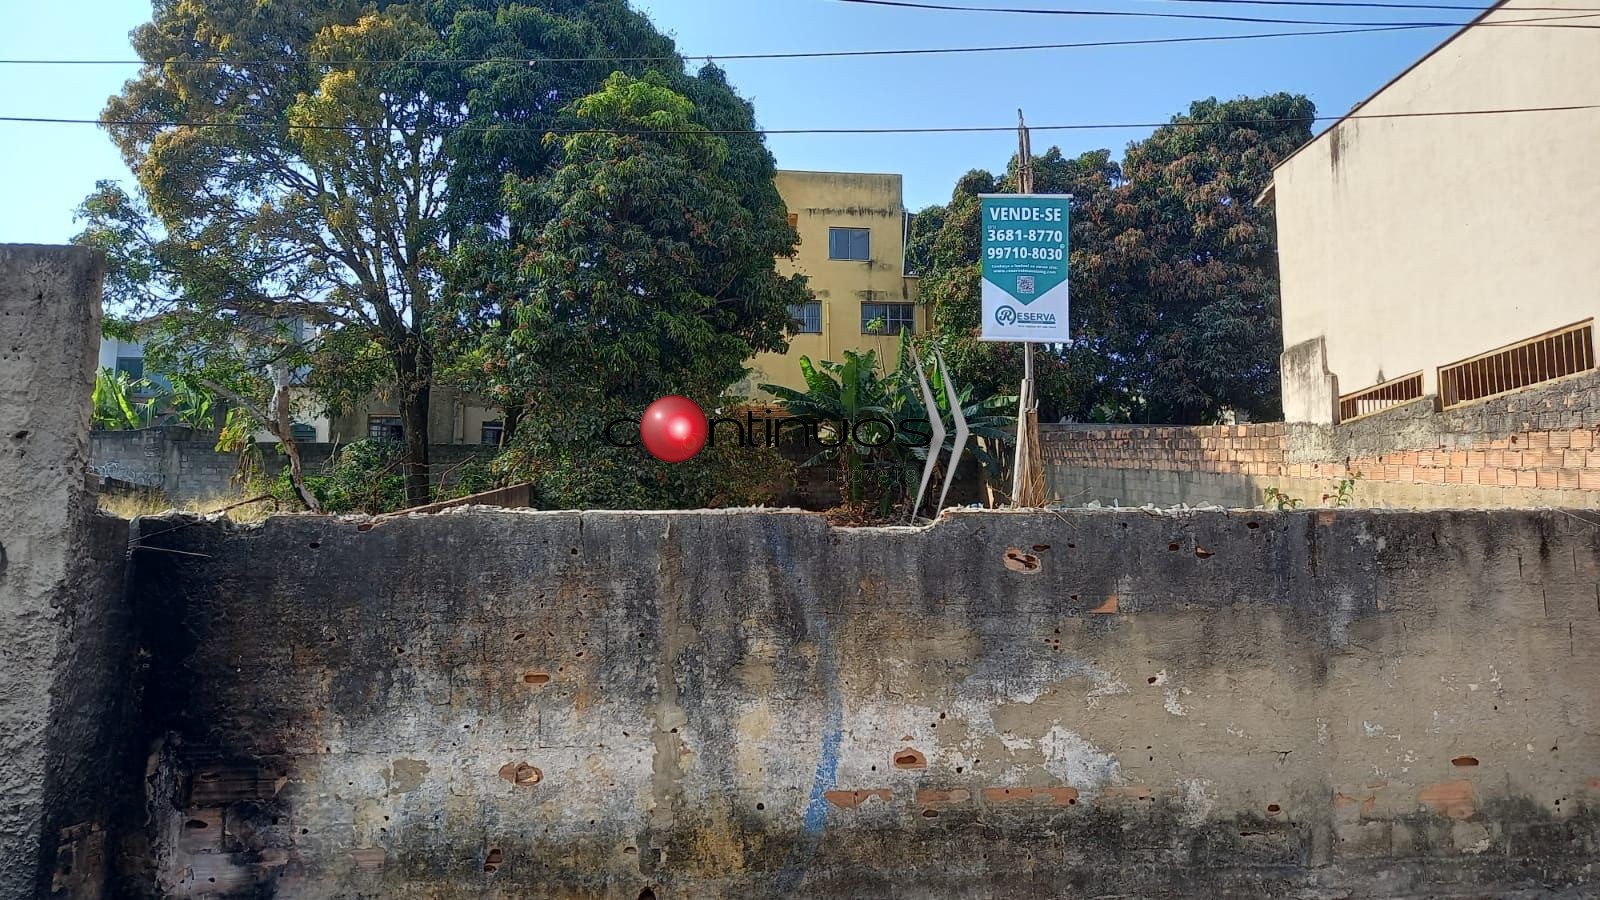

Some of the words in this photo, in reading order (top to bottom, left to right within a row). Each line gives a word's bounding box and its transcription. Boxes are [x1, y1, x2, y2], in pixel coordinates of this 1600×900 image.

[989, 207, 1061, 221] VENDE-SE
[987, 229, 1063, 242] 3681-8770
[987, 247, 1063, 260] 99710-8030
